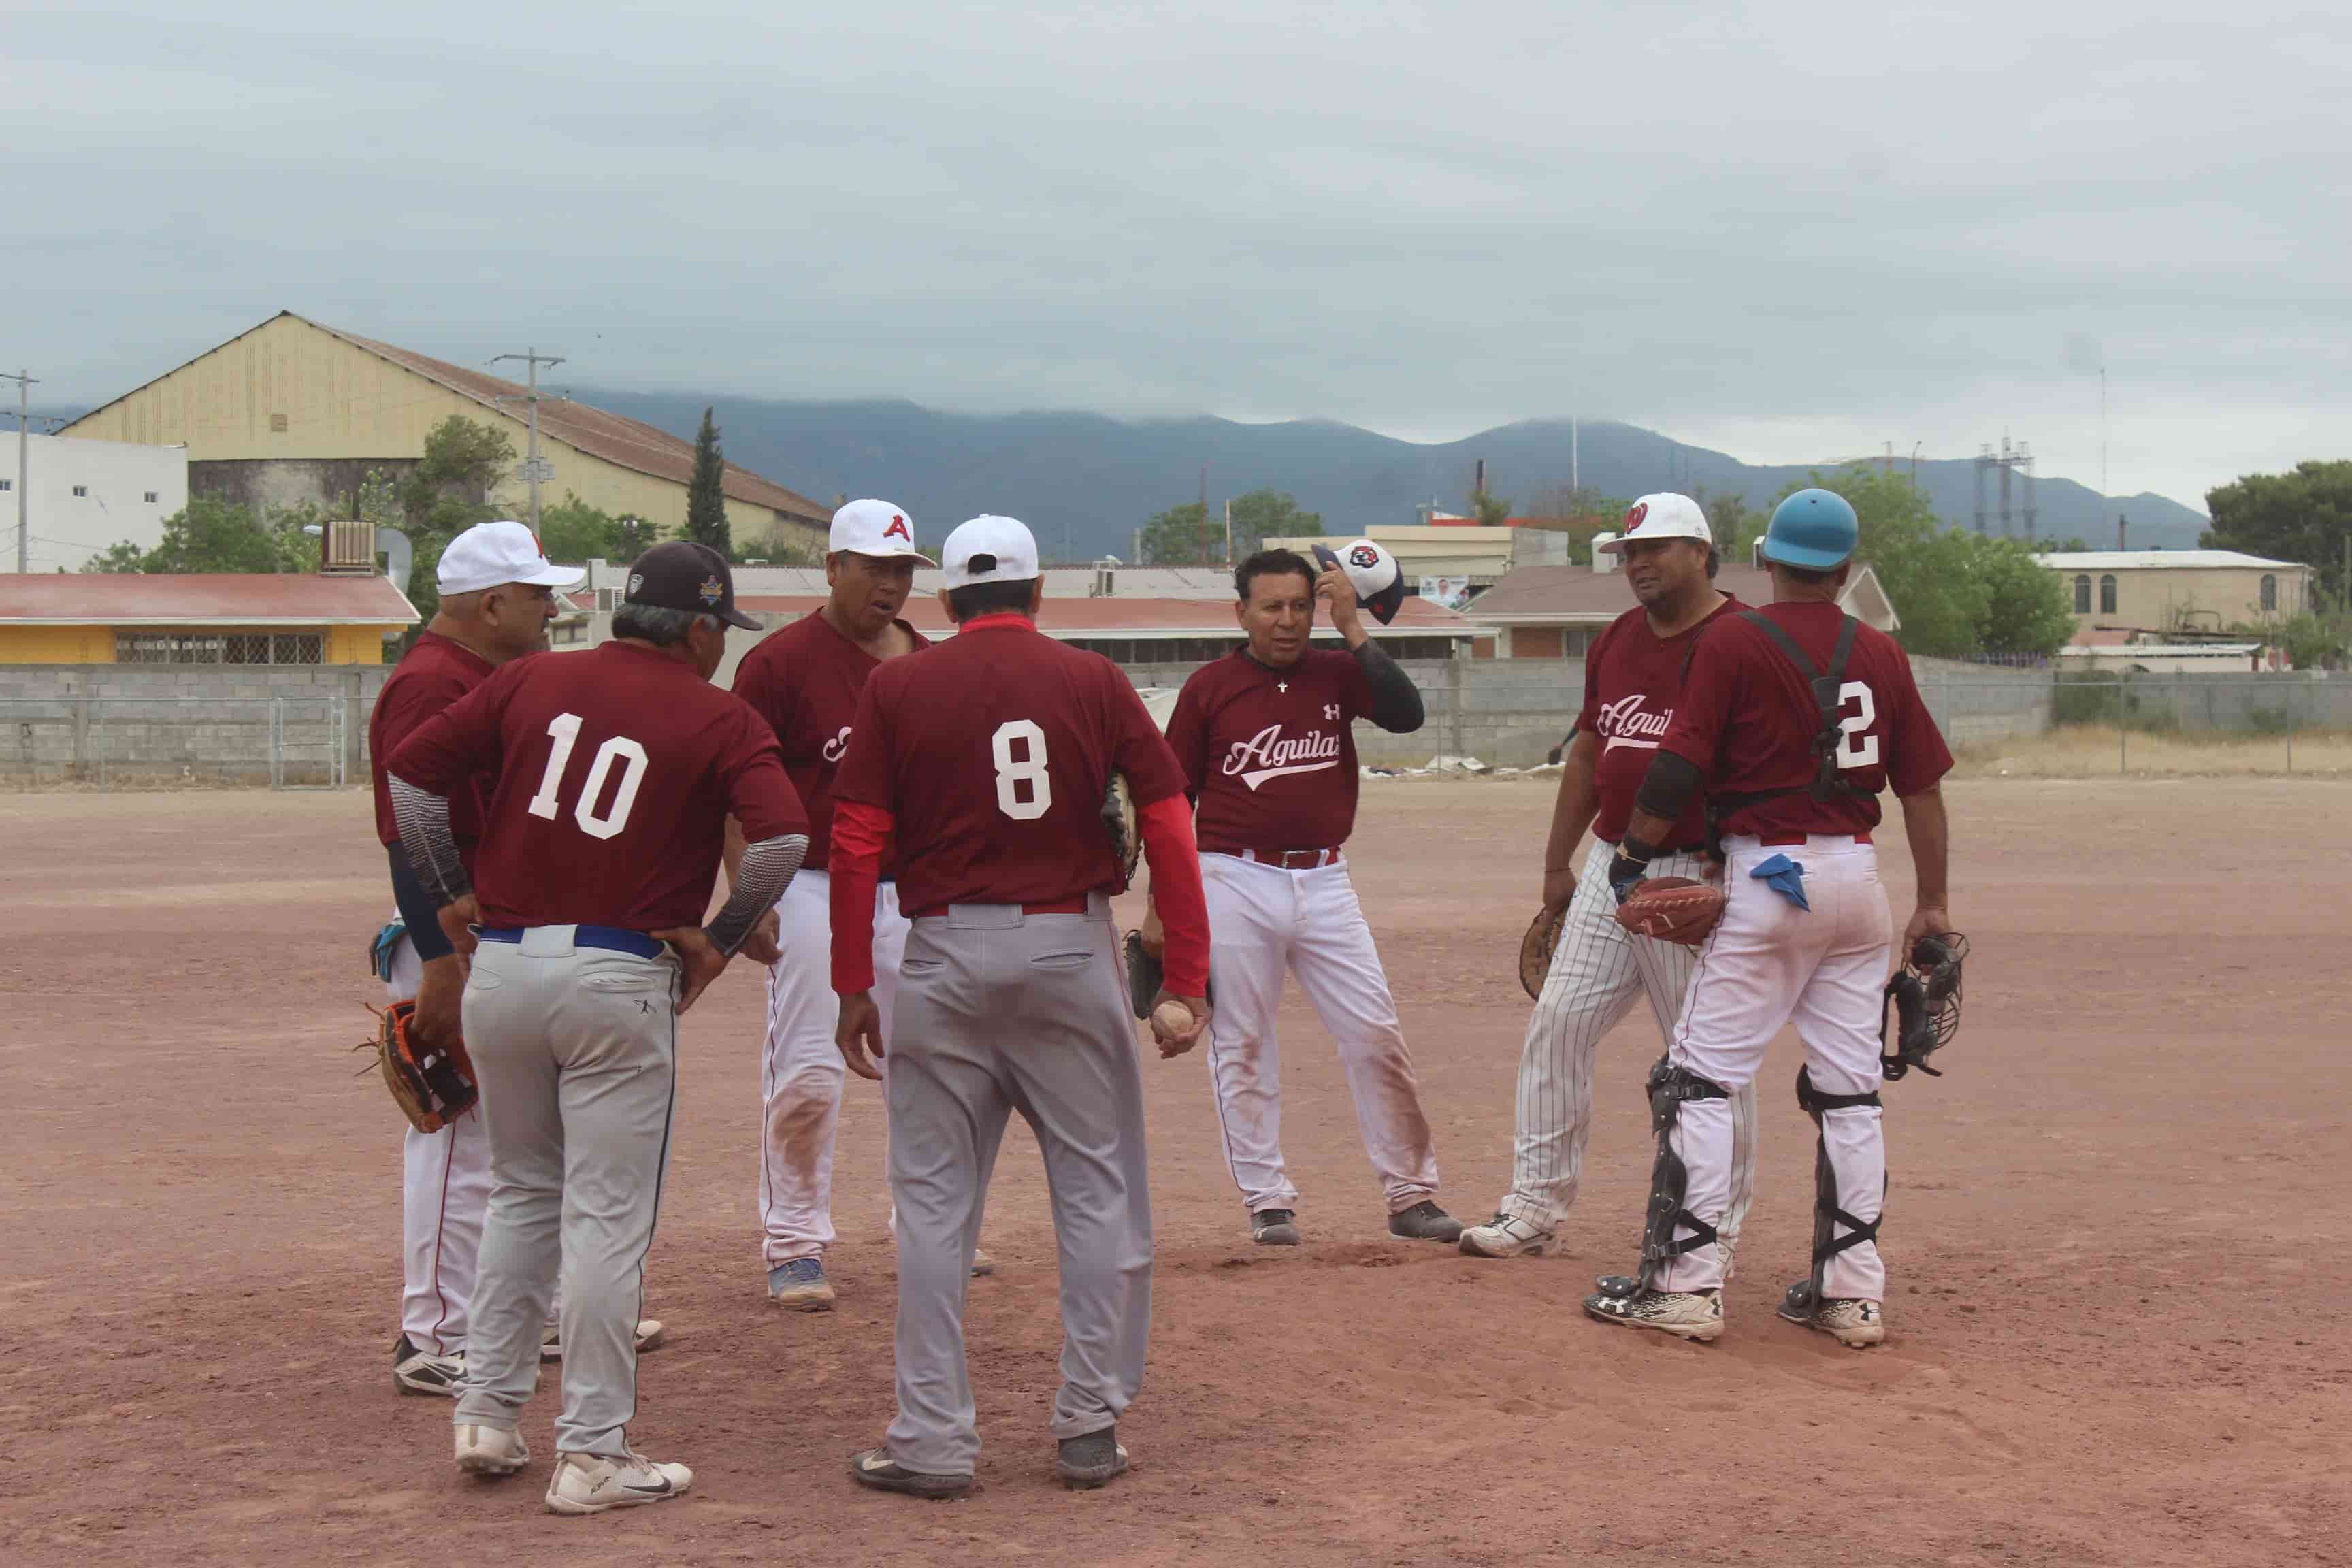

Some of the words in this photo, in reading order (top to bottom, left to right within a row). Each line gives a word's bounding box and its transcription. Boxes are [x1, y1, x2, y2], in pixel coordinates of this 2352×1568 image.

[882, 514, 911, 543] A
[992, 719, 1052, 821] 8
[1835, 681, 1879, 769] 2
[527, 713, 649, 840] 10
